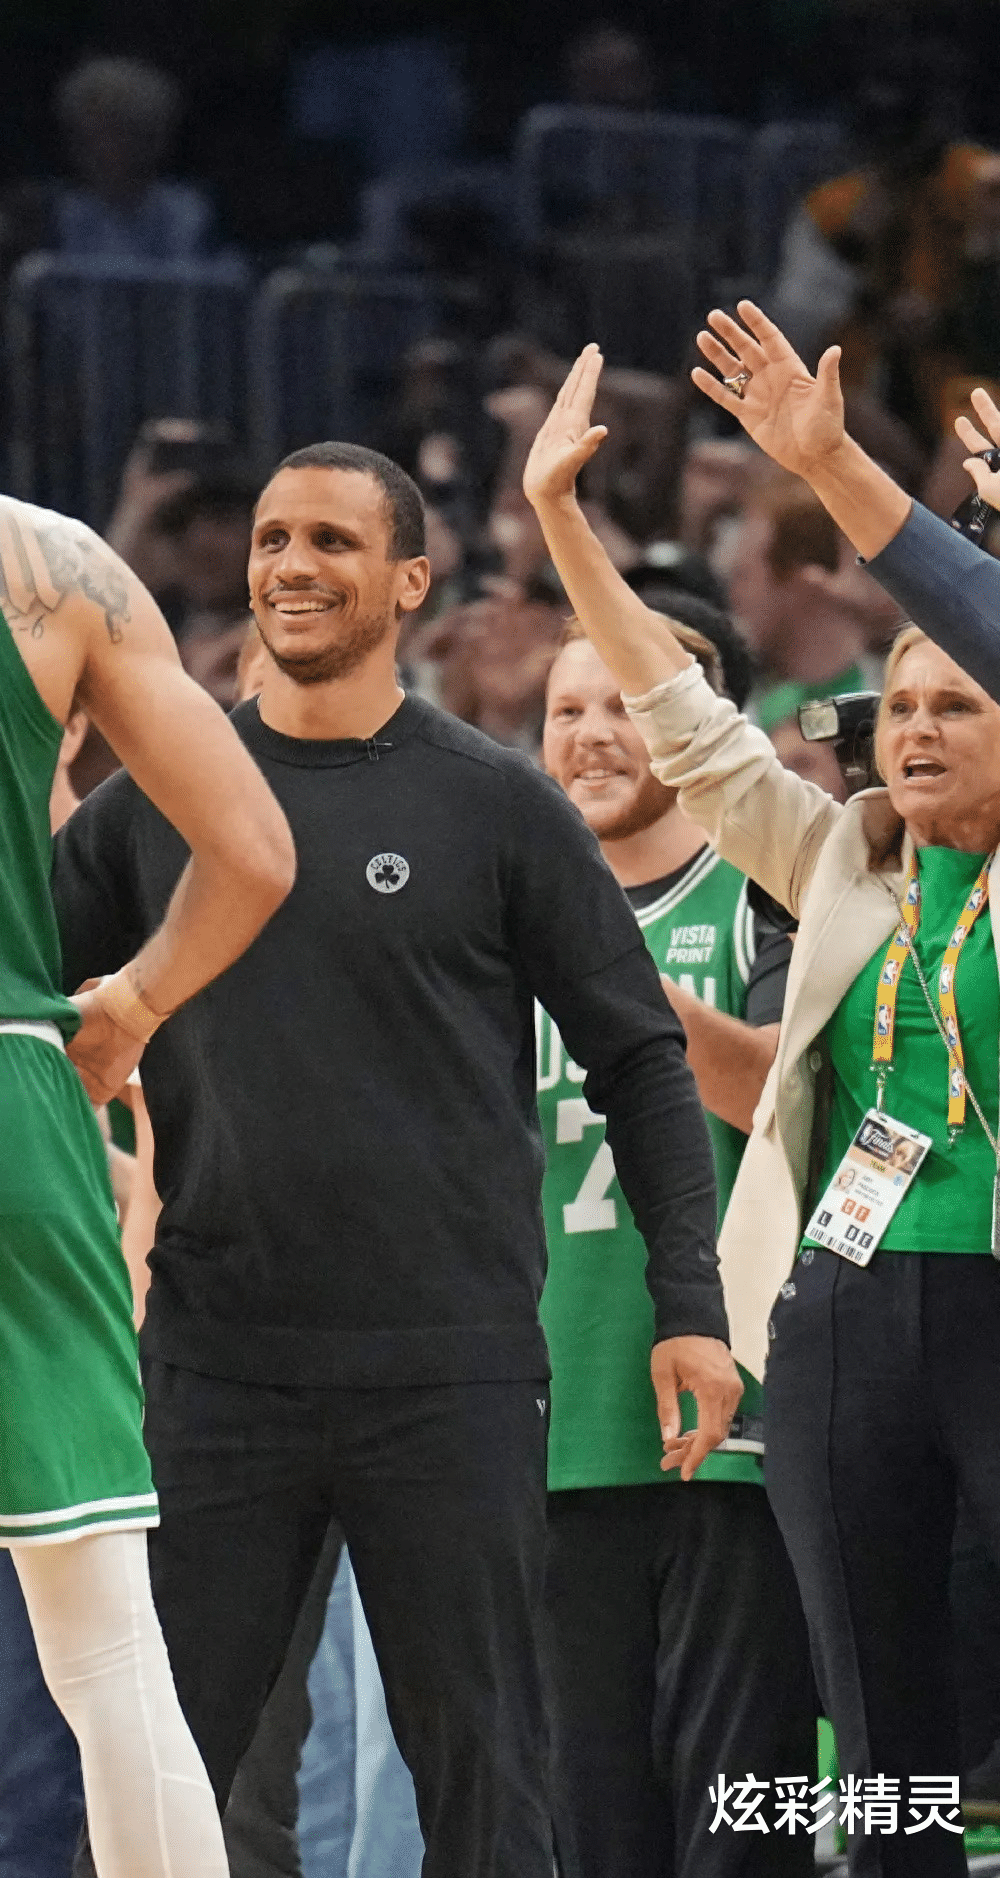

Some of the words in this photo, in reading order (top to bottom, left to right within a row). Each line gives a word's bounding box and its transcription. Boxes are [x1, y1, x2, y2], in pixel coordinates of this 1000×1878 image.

[370, 855, 407, 872] CELTICS
[671, 925, 715, 946] VISTA
[666, 947, 713, 963] PRINT
[556, 1098, 618, 1234] 7
